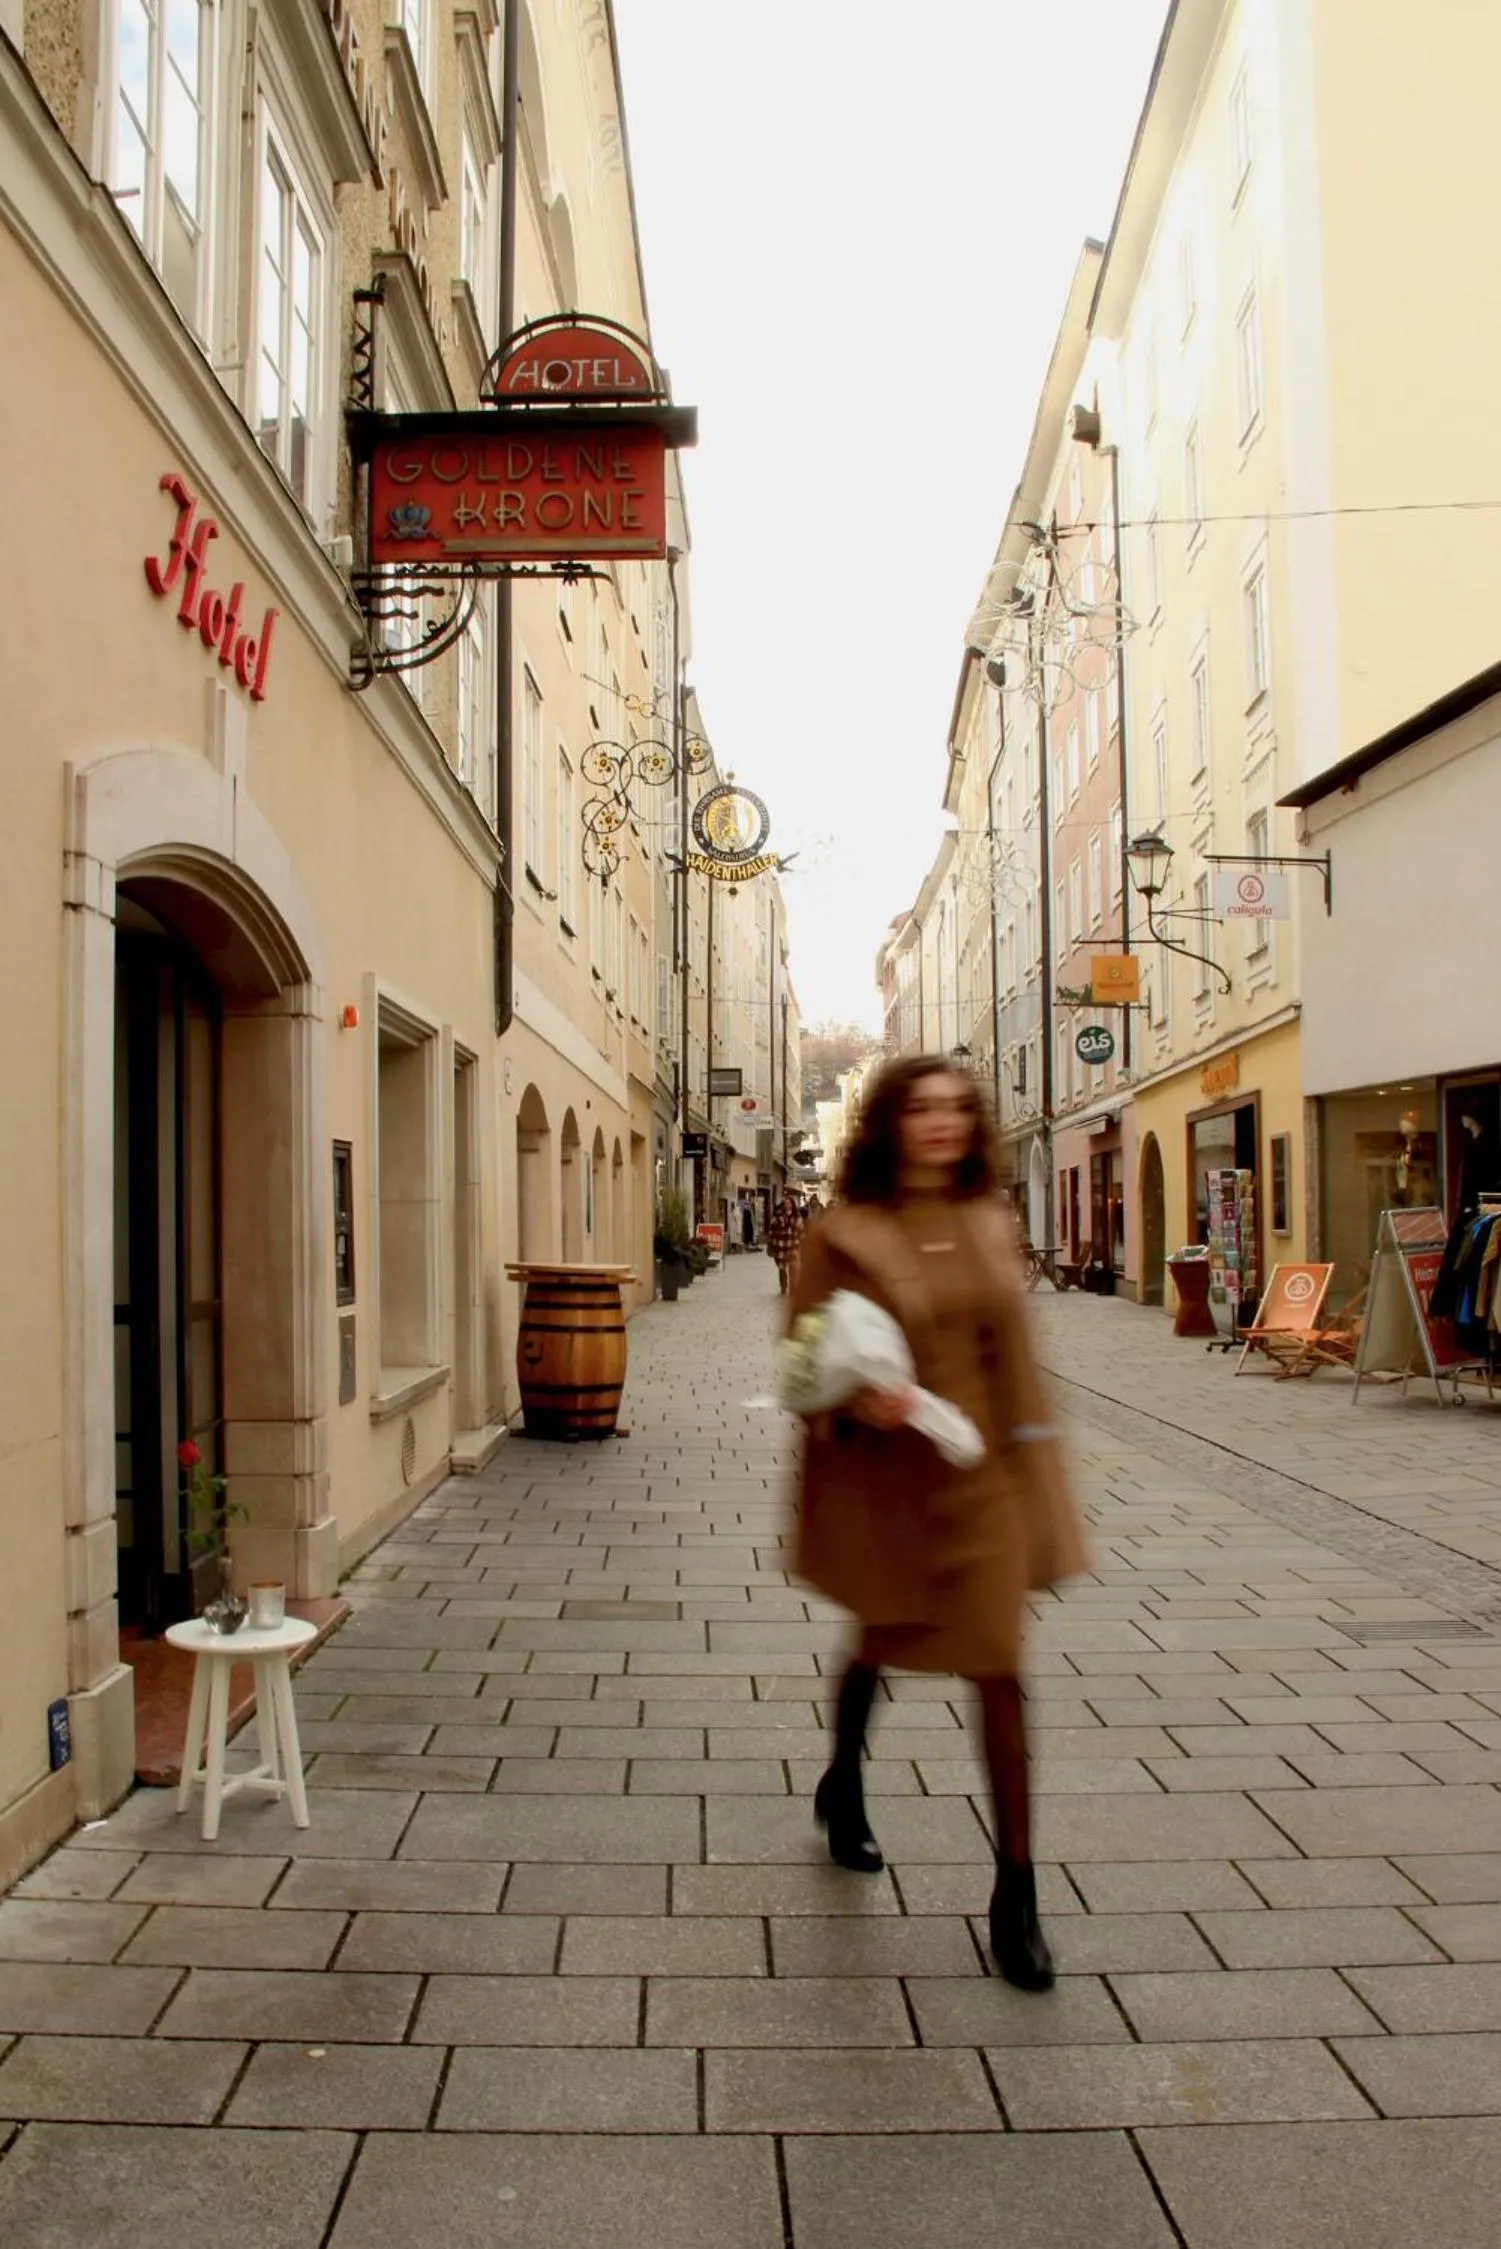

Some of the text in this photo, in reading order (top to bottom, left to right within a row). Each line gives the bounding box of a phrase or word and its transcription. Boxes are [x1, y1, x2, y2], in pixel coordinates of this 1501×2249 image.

[508, 358, 636, 388] HOTEL
[386, 442, 637, 483] GOLDENE
[453, 489, 650, 530] KRONE
[144, 473, 280, 702] Hotel
[1078, 1030, 1111, 1053] eis
